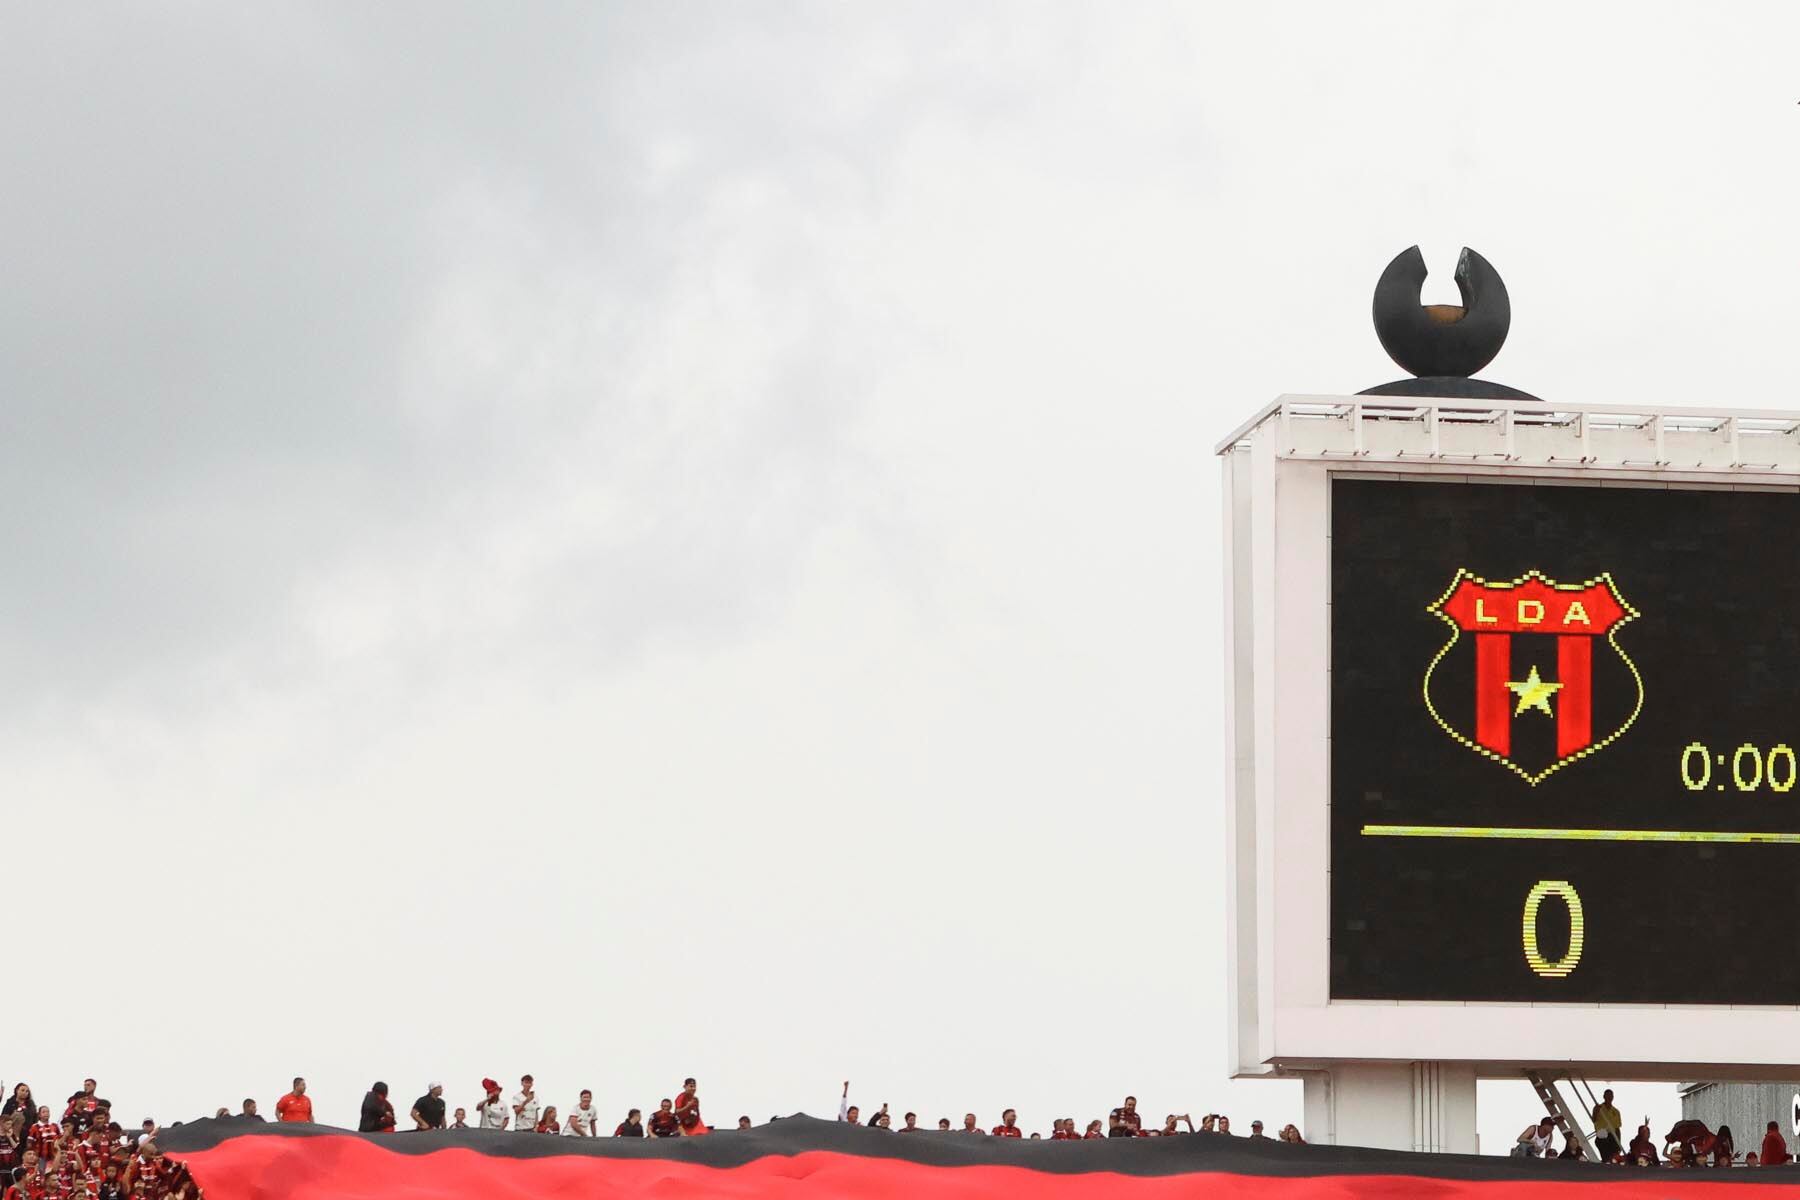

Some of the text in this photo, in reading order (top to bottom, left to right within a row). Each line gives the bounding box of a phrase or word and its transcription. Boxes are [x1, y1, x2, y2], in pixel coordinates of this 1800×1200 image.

[1475, 600, 1591, 626] LDA
[1681, 742, 1797, 792] 0:00
[1523, 881, 1584, 977] 0
